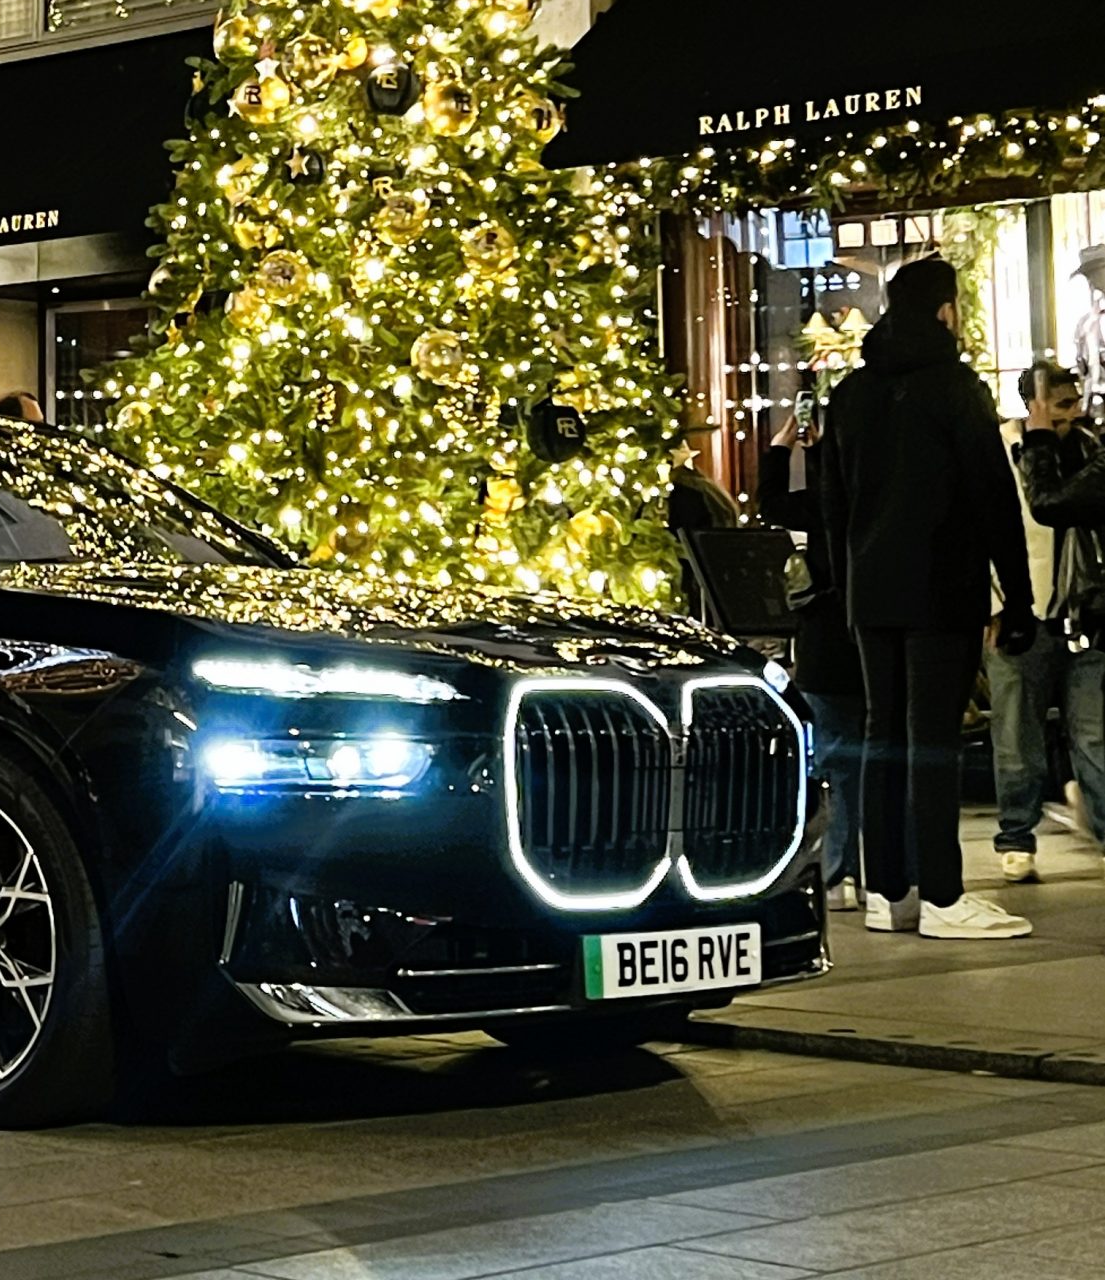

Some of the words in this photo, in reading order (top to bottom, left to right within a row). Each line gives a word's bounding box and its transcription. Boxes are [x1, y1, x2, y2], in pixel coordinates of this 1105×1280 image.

[699, 105, 791, 135] RALPH
[805, 86, 922, 122] LAUREN
[617, 938, 689, 987] BE16
[698, 932, 751, 980] RVE
